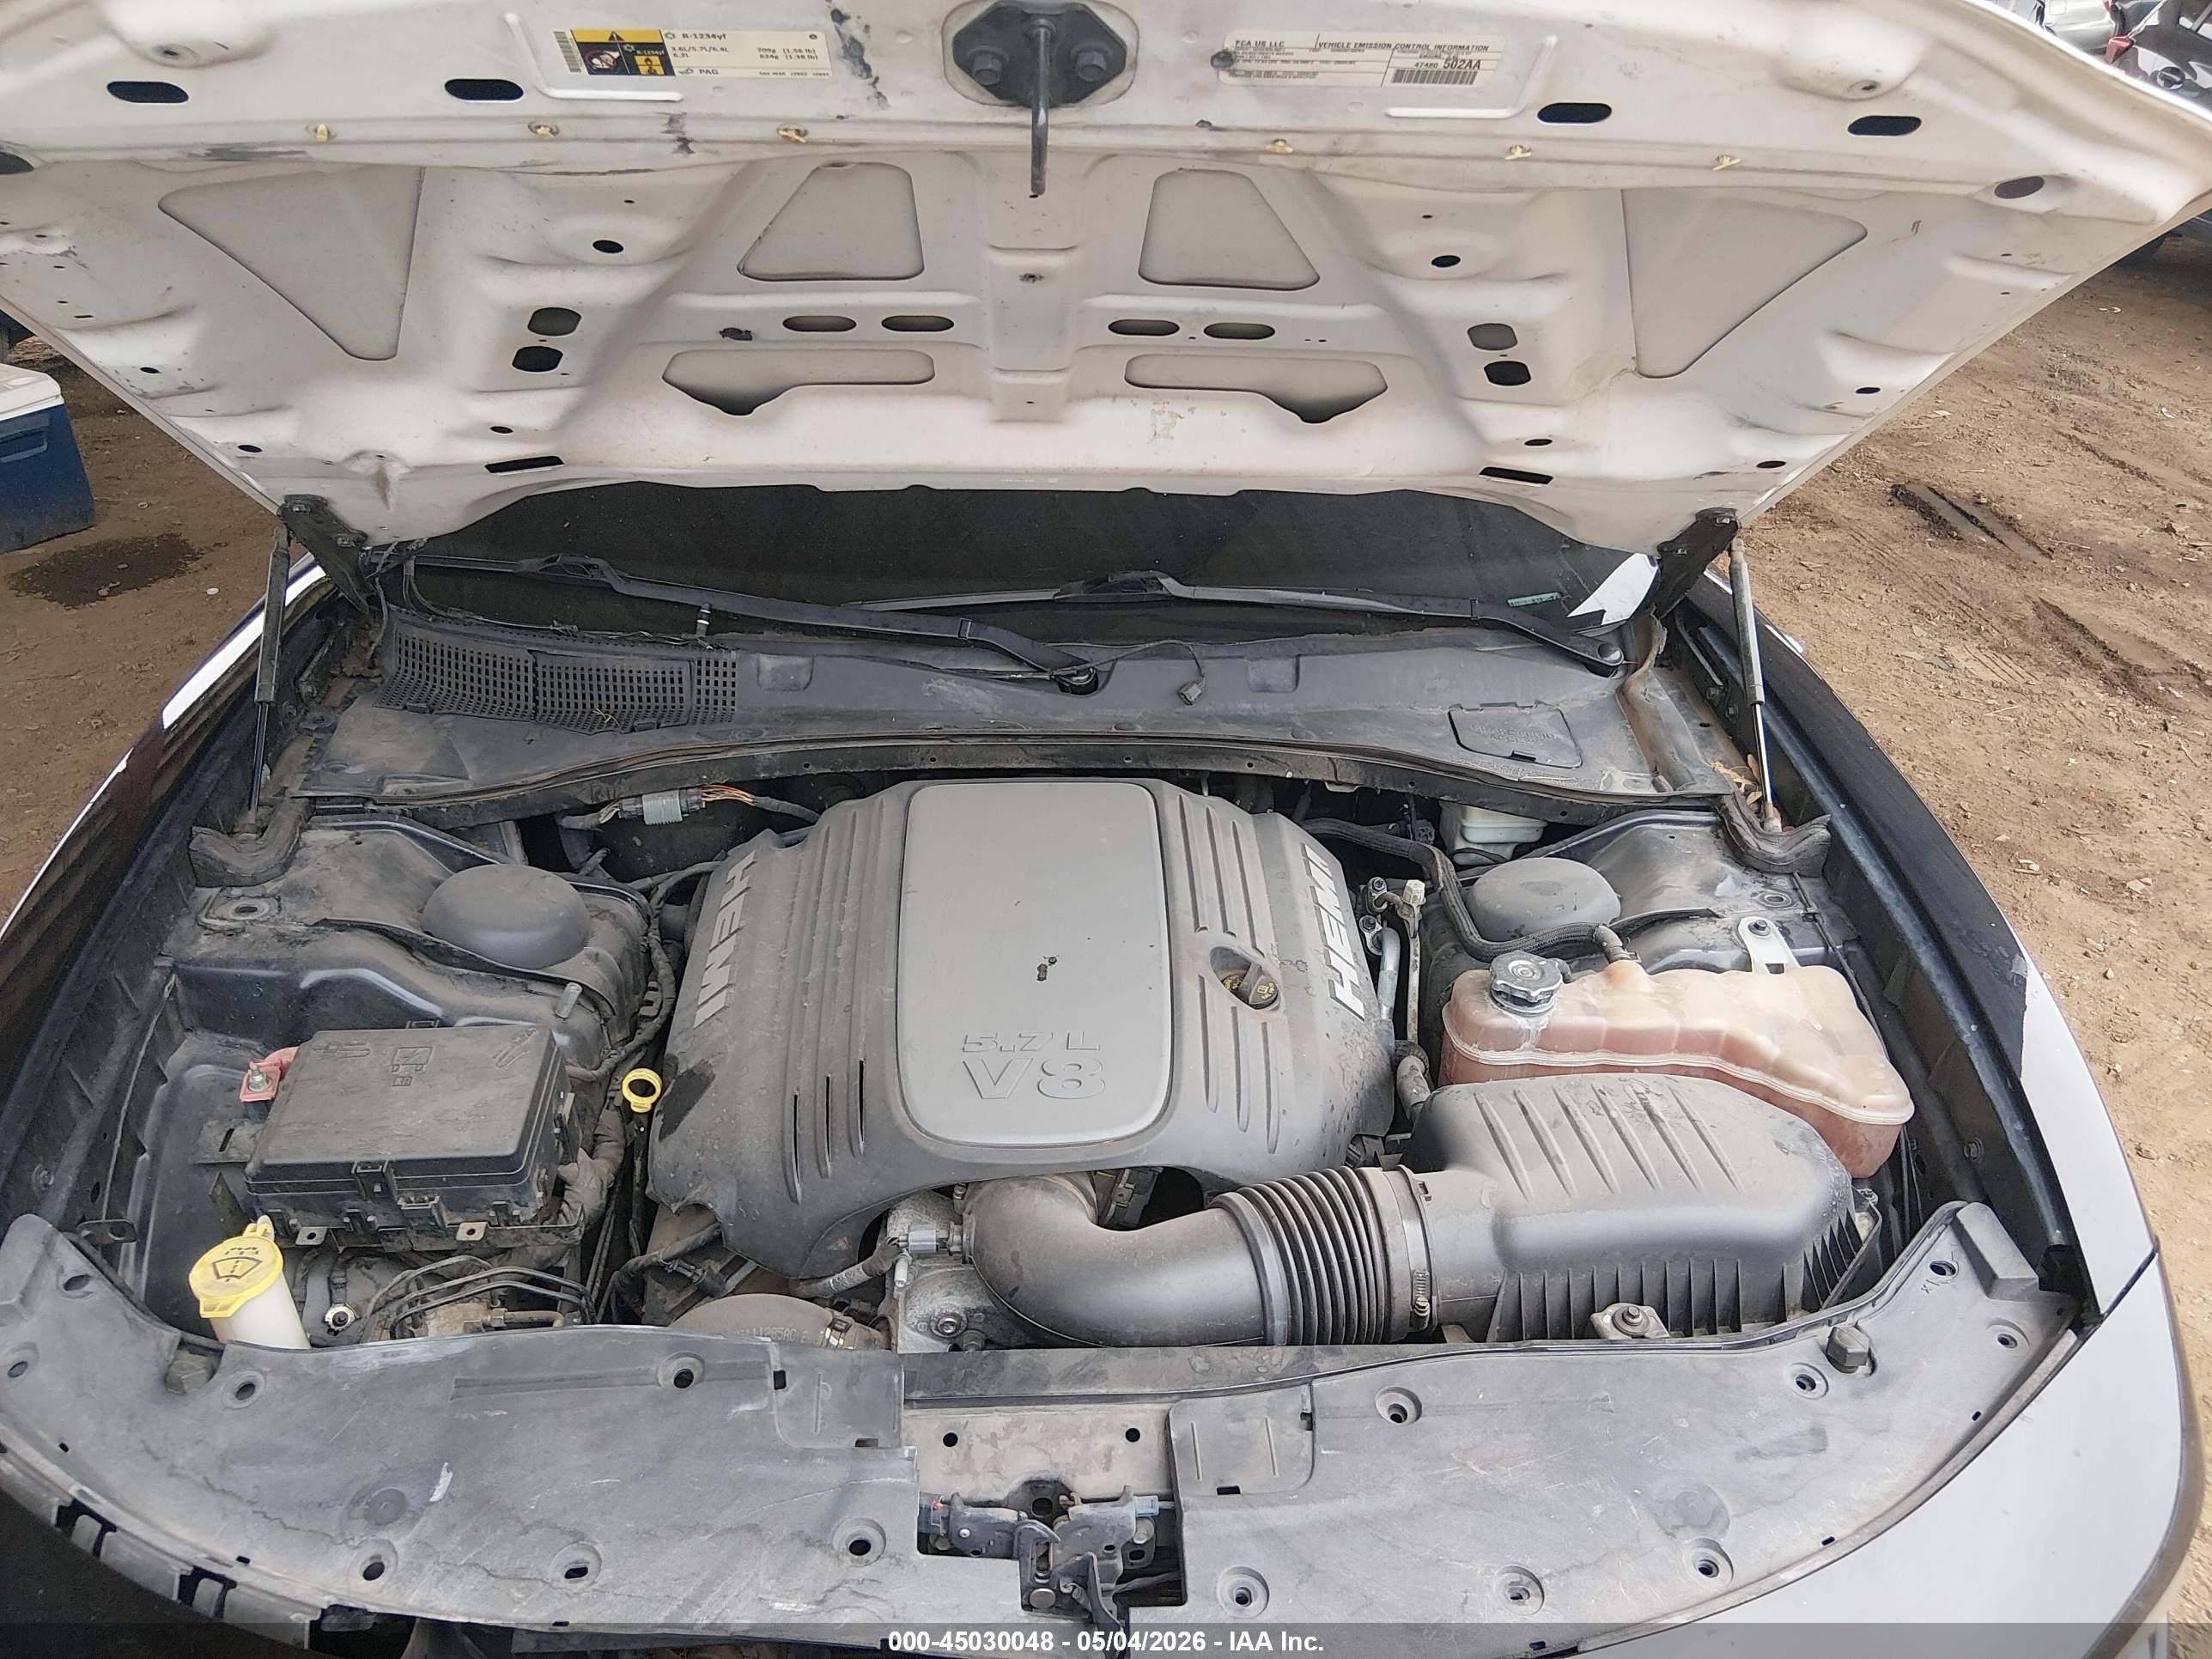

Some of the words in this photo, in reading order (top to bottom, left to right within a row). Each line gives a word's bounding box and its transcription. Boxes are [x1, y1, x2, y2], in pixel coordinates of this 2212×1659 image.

[1443, 59, 1481, 70] 502AA
[962, 1030, 1102, 1054] 5.7L
[963, 1057, 1106, 1099] V8
